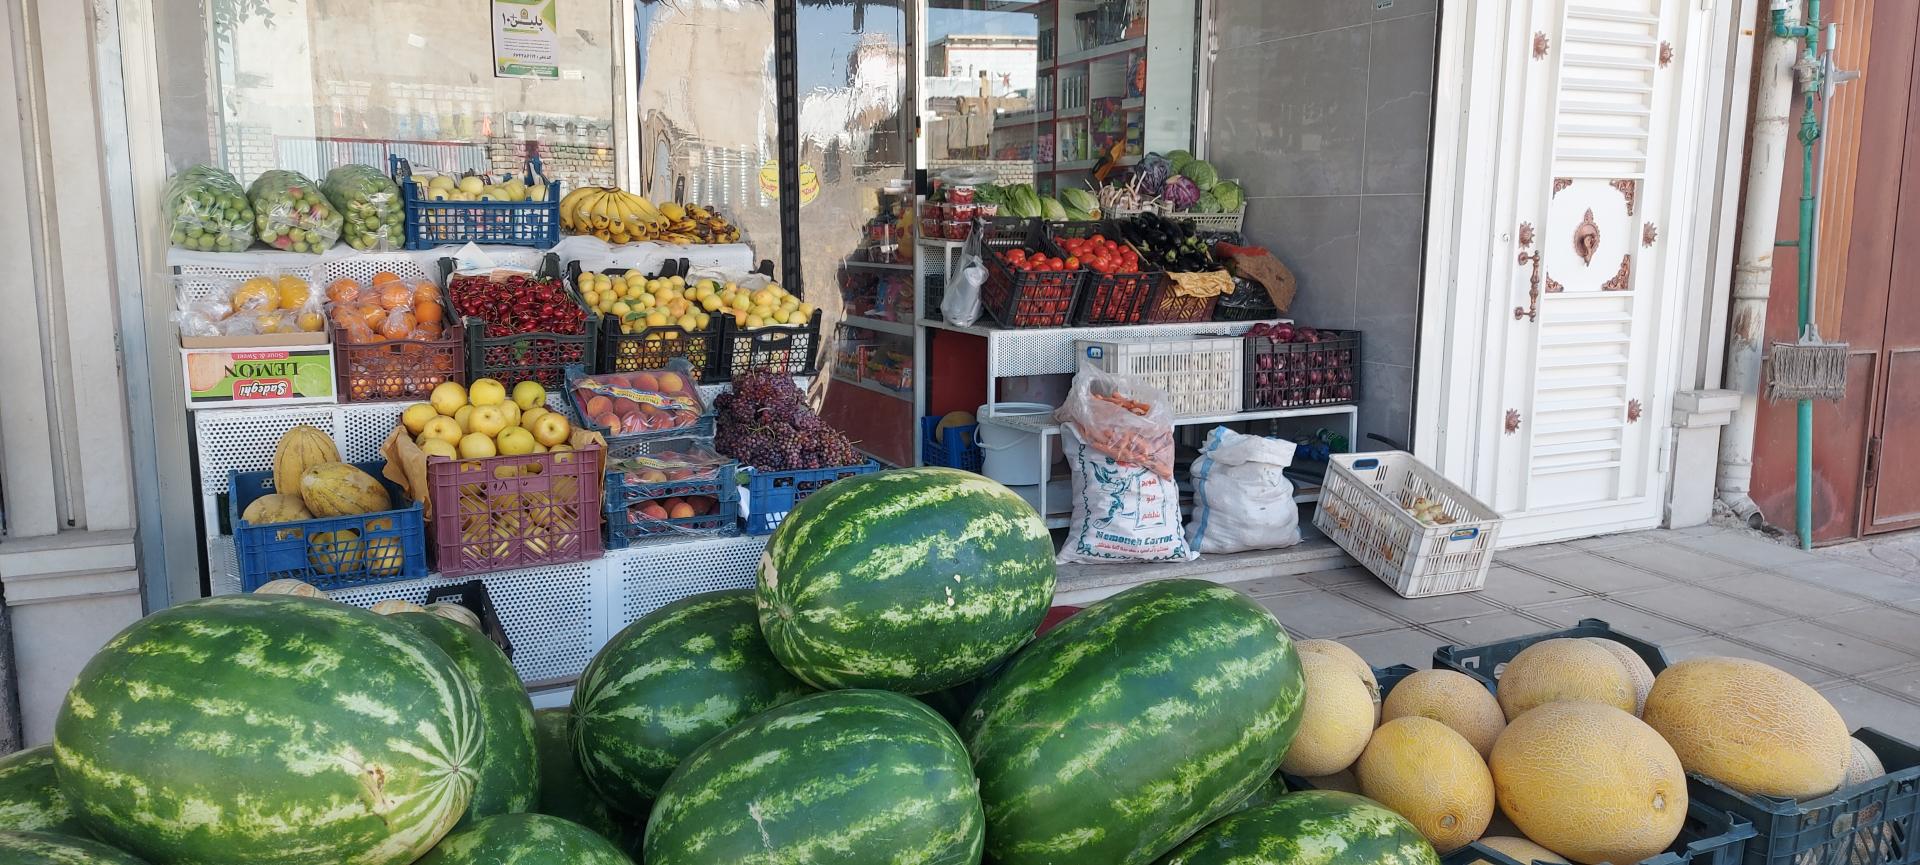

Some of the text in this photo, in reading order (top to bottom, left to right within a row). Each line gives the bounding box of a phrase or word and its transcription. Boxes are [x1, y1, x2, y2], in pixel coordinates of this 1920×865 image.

[224, 361, 299, 378] LEMON
[239, 380, 287, 396] Sadeghi
[1144, 534, 1174, 546] Carrot
